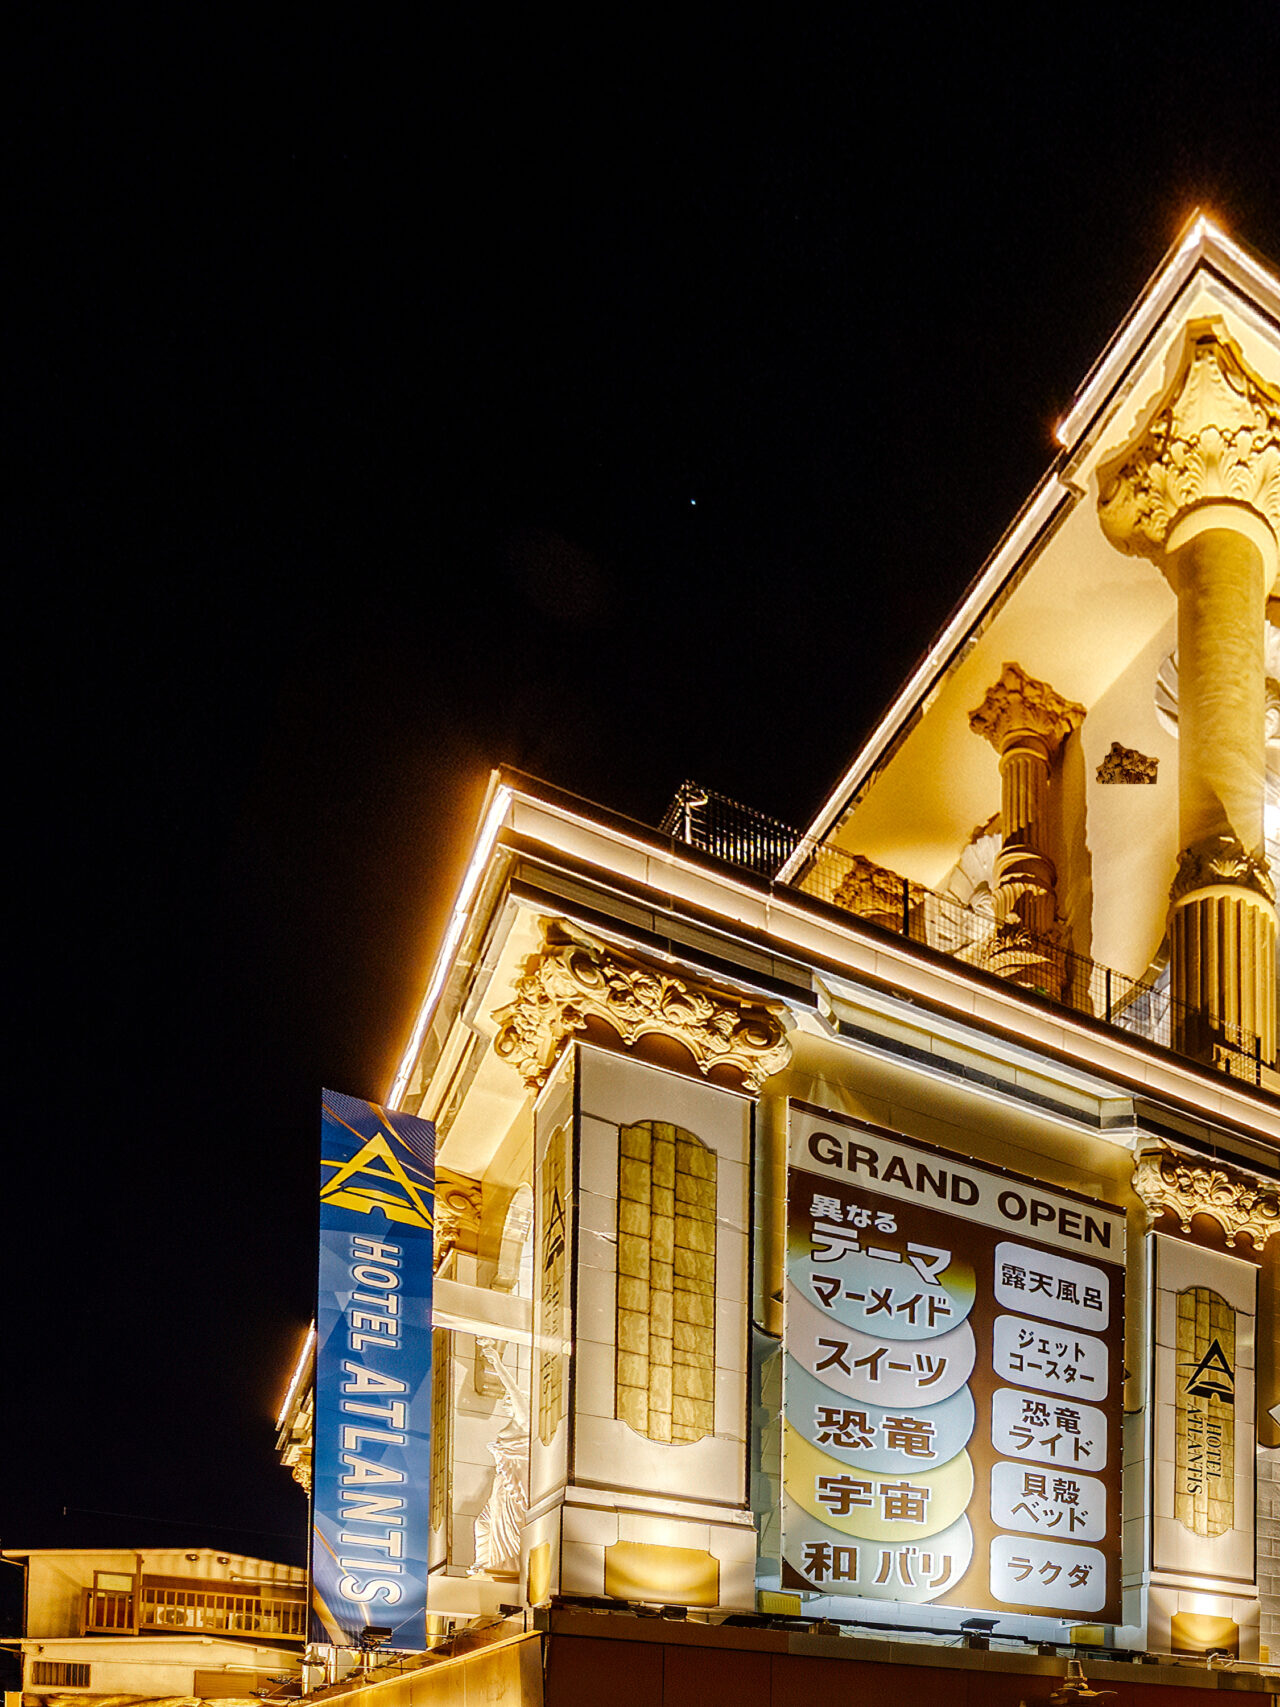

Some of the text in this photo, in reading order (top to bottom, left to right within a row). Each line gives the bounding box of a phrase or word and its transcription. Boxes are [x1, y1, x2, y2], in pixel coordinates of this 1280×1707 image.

[807, 1131, 1112, 1249] GRAND OPEN
[809, 1193, 898, 1234] 異なる
[811, 1221, 952, 1286] テーマ
[812, 1274, 951, 1327] マーメイド
[1001, 1263, 1103, 1312] 露天風呂
[816, 1338, 947, 1387] スイーツ
[1009, 1352, 1095, 1384] コースター
[1018, 1328, 1086, 1363] ジェット
[338, 1236, 407, 1607] HOTEL ATLANTIS
[816, 1406, 936, 1458] 恐竜
[1021, 1398, 1082, 1435] 恐竜
[1008, 1425, 1094, 1462] ライド
[1187, 1402, 1203, 1496] ATLANTIS
[1206, 1420, 1222, 1481] HOTEL
[818, 1475, 930, 1523] 宇宙
[1020, 1472, 1081, 1507] 貝殻
[1010, 1501, 1089, 1533] ベッド
[1007, 1556, 1094, 1588] ラクダ
